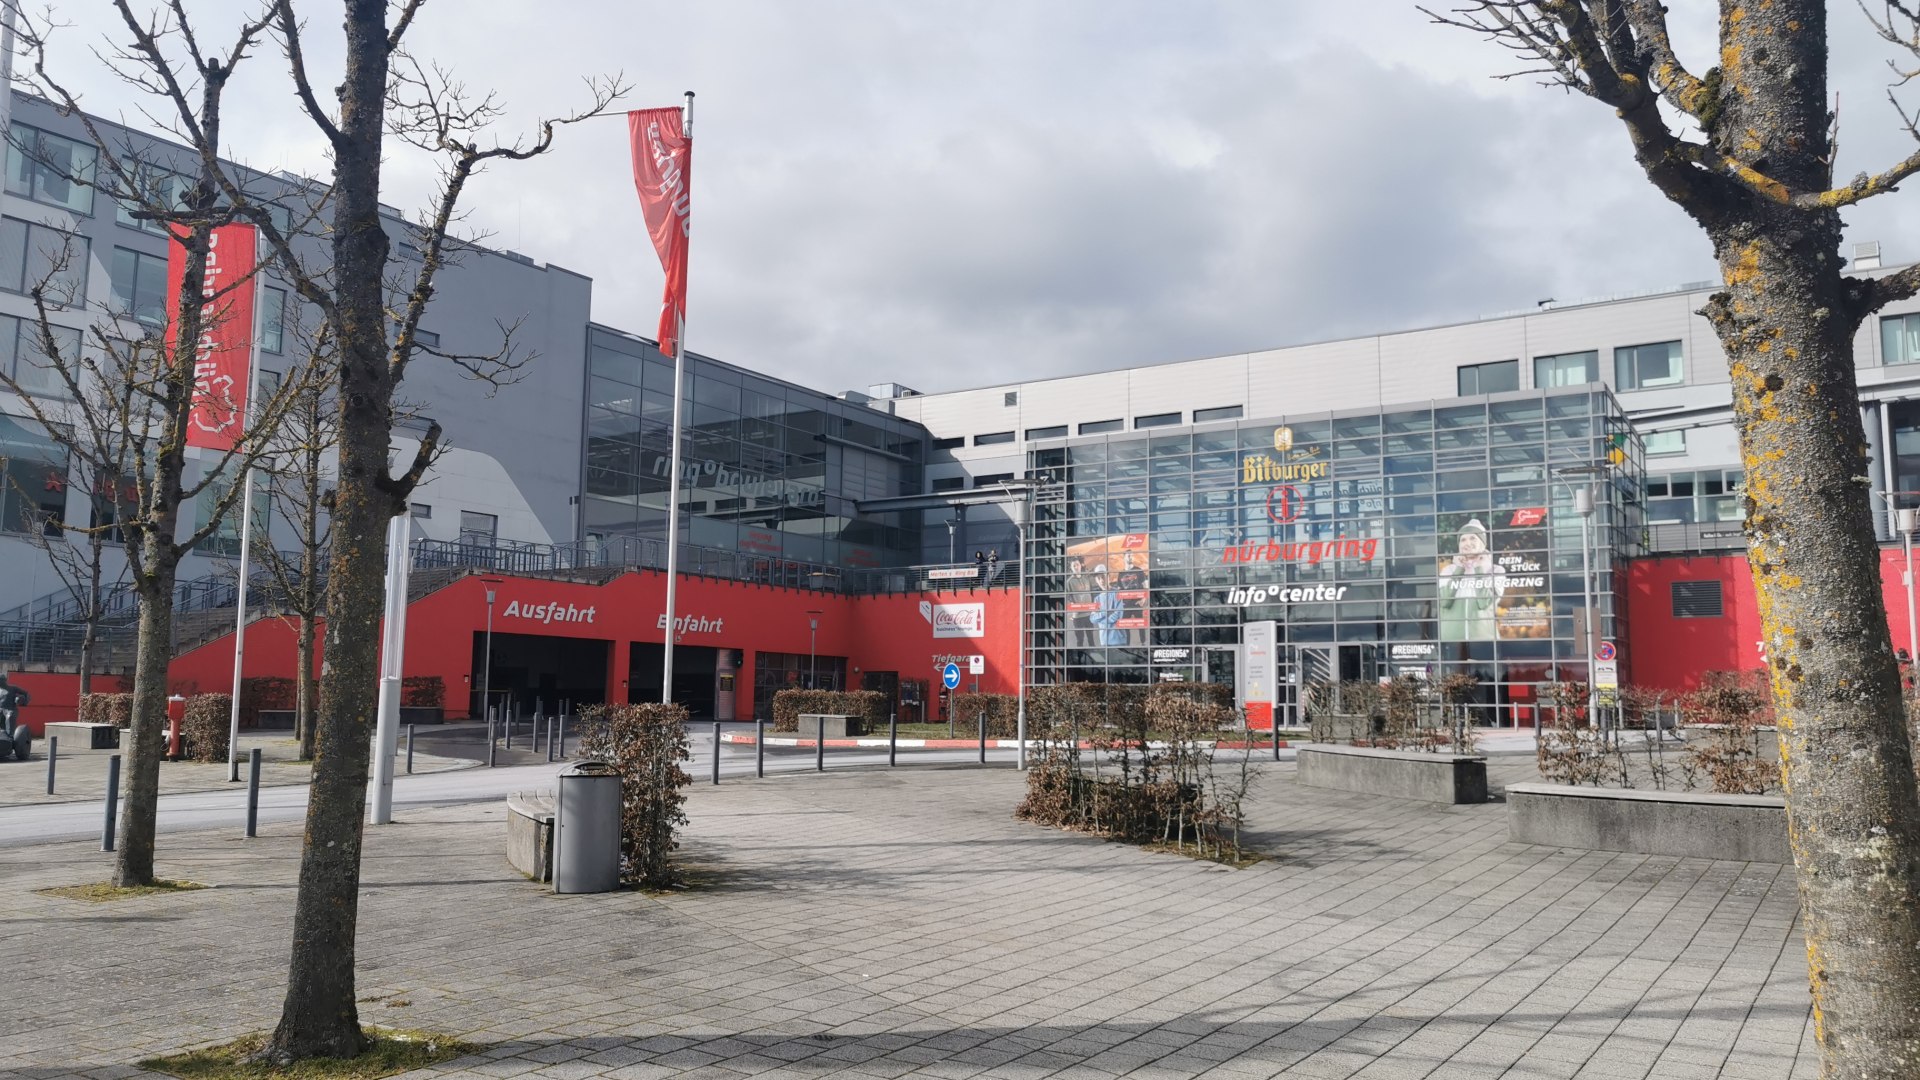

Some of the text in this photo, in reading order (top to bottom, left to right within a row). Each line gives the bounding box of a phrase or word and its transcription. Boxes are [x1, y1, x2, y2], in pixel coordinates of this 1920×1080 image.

[1242, 456, 1328, 483] Bitburger
[1222, 534, 1377, 565] nürburgring
[1498, 557, 1522, 565] DEIN
[1510, 563, 1540, 572] STÜCK
[1227, 584, 1347, 607] info°center
[503, 600, 596, 624] Ausfahrt
[656, 613, 724, 634] Enfahrt
[932, 654, 971, 664] Tiefgara
